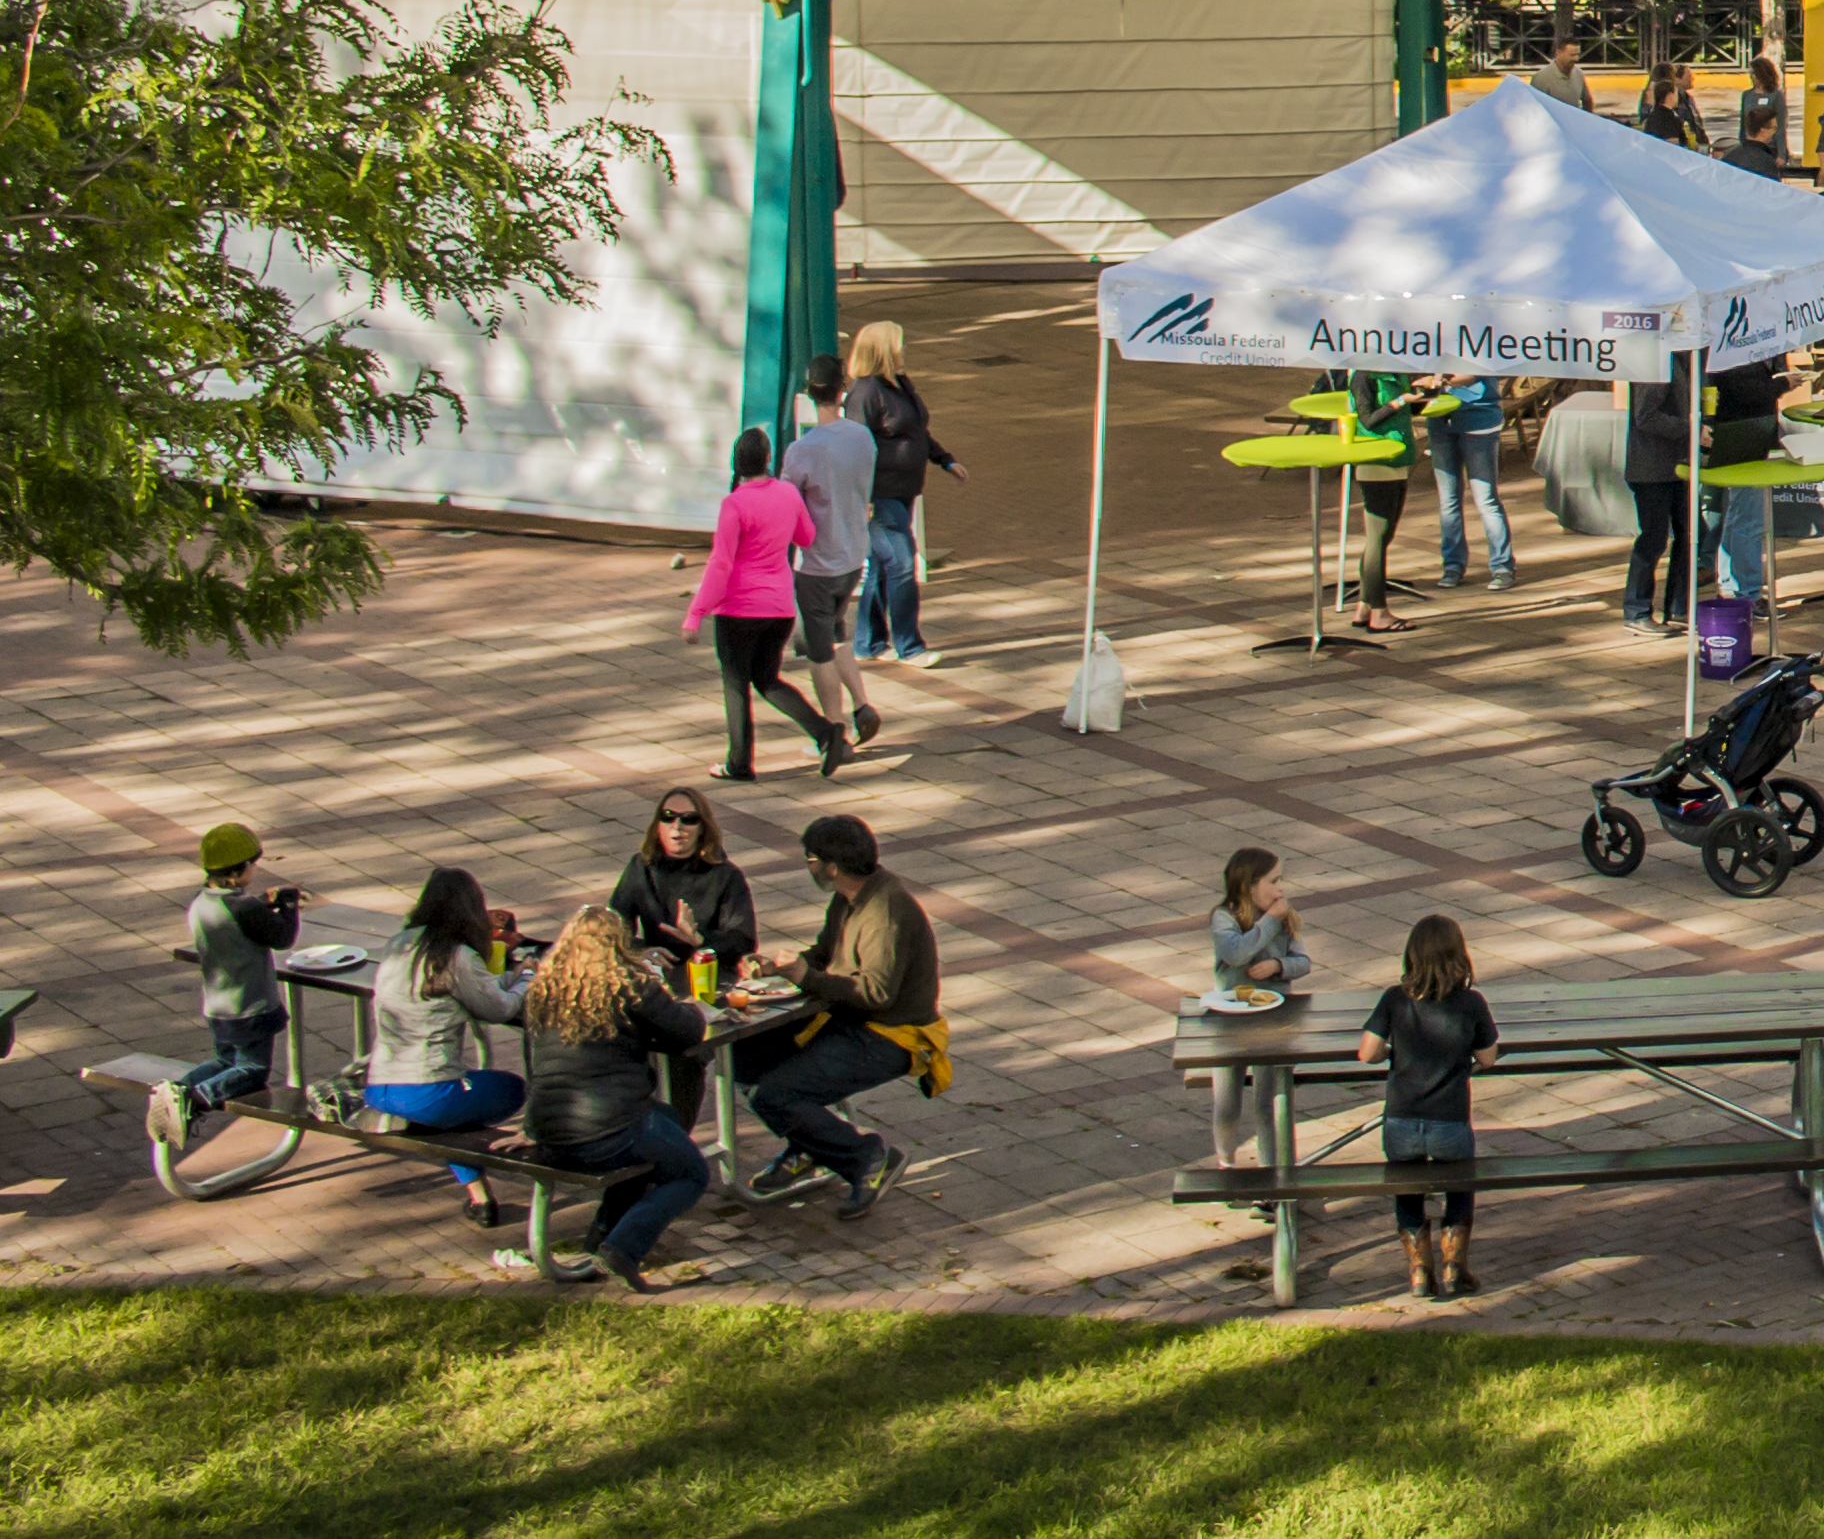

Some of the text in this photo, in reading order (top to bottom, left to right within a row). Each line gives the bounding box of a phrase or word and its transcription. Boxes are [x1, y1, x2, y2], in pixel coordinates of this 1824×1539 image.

[1612, 314, 1653, 330] 2016
[1160, 331, 1286, 349] Missoula Federal
[1309, 318, 1617, 373] Annual Meeting
[1200, 351, 1286, 368] Credit Union
[1773, 492, 1794, 503] edit
